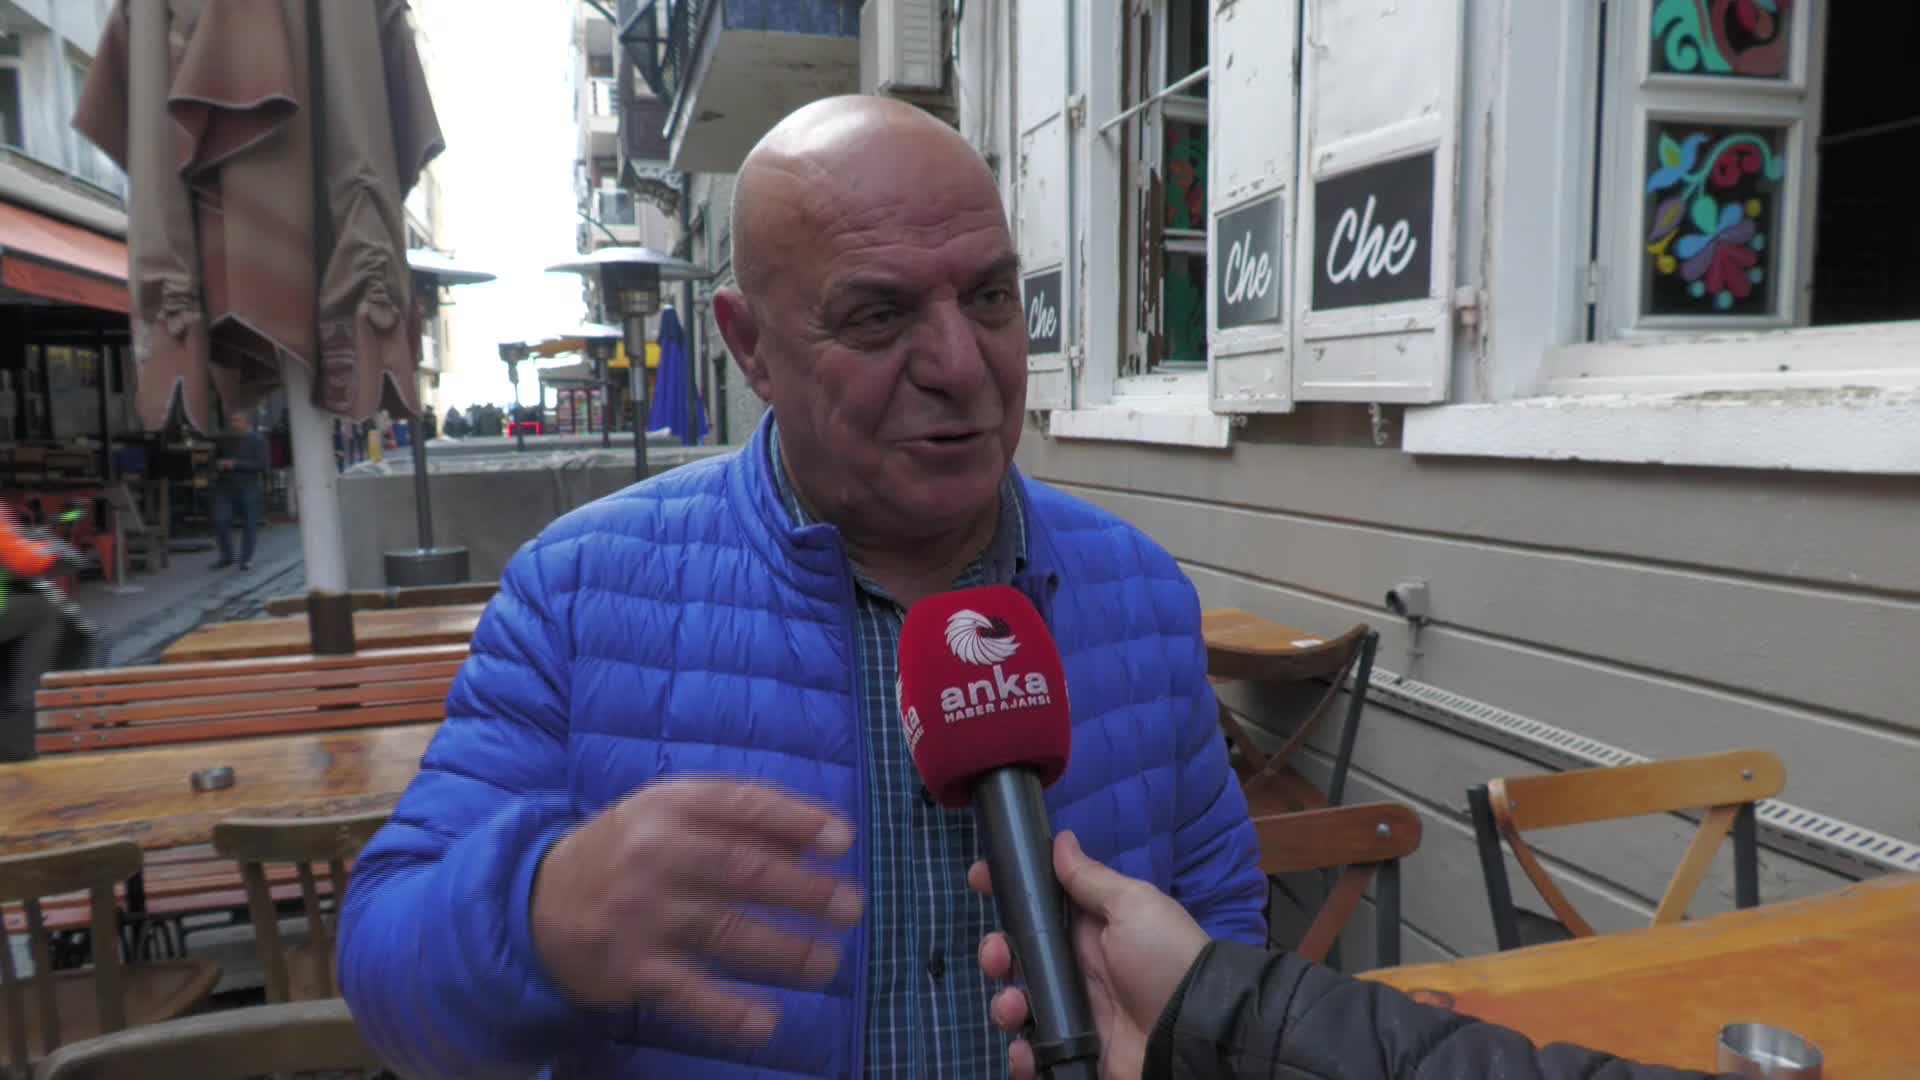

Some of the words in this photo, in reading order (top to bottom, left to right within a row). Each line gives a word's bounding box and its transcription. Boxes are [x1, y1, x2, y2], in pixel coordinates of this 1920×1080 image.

[1326, 194, 1417, 285] Che
[1224, 231, 1272, 305] Che
[1028, 292, 1057, 339] Che
[940, 664, 1049, 712] anka
[944, 703, 995, 724] HABER
[1000, 695, 1051, 711] AJANSI
